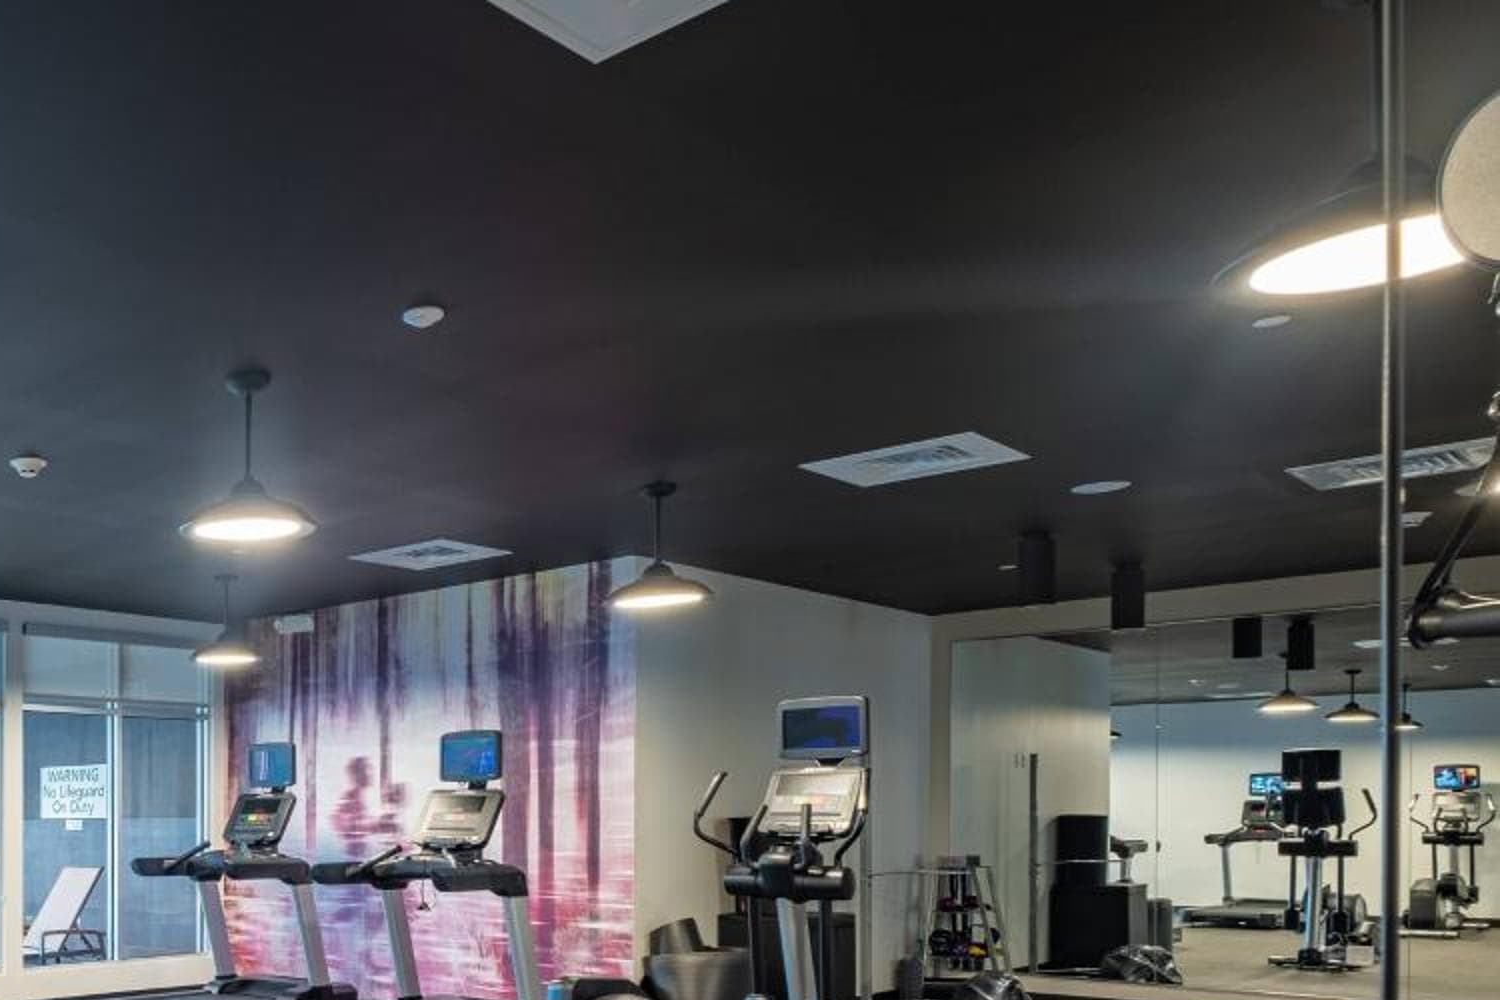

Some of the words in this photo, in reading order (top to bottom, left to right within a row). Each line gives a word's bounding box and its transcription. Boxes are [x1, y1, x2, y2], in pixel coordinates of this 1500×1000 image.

[48, 767, 99, 782] WARNING
[43, 785, 57, 798] No
[60, 784, 104, 801] Lifeguard
[52, 800, 67, 814] On
[69, 800, 95, 816] Duty
